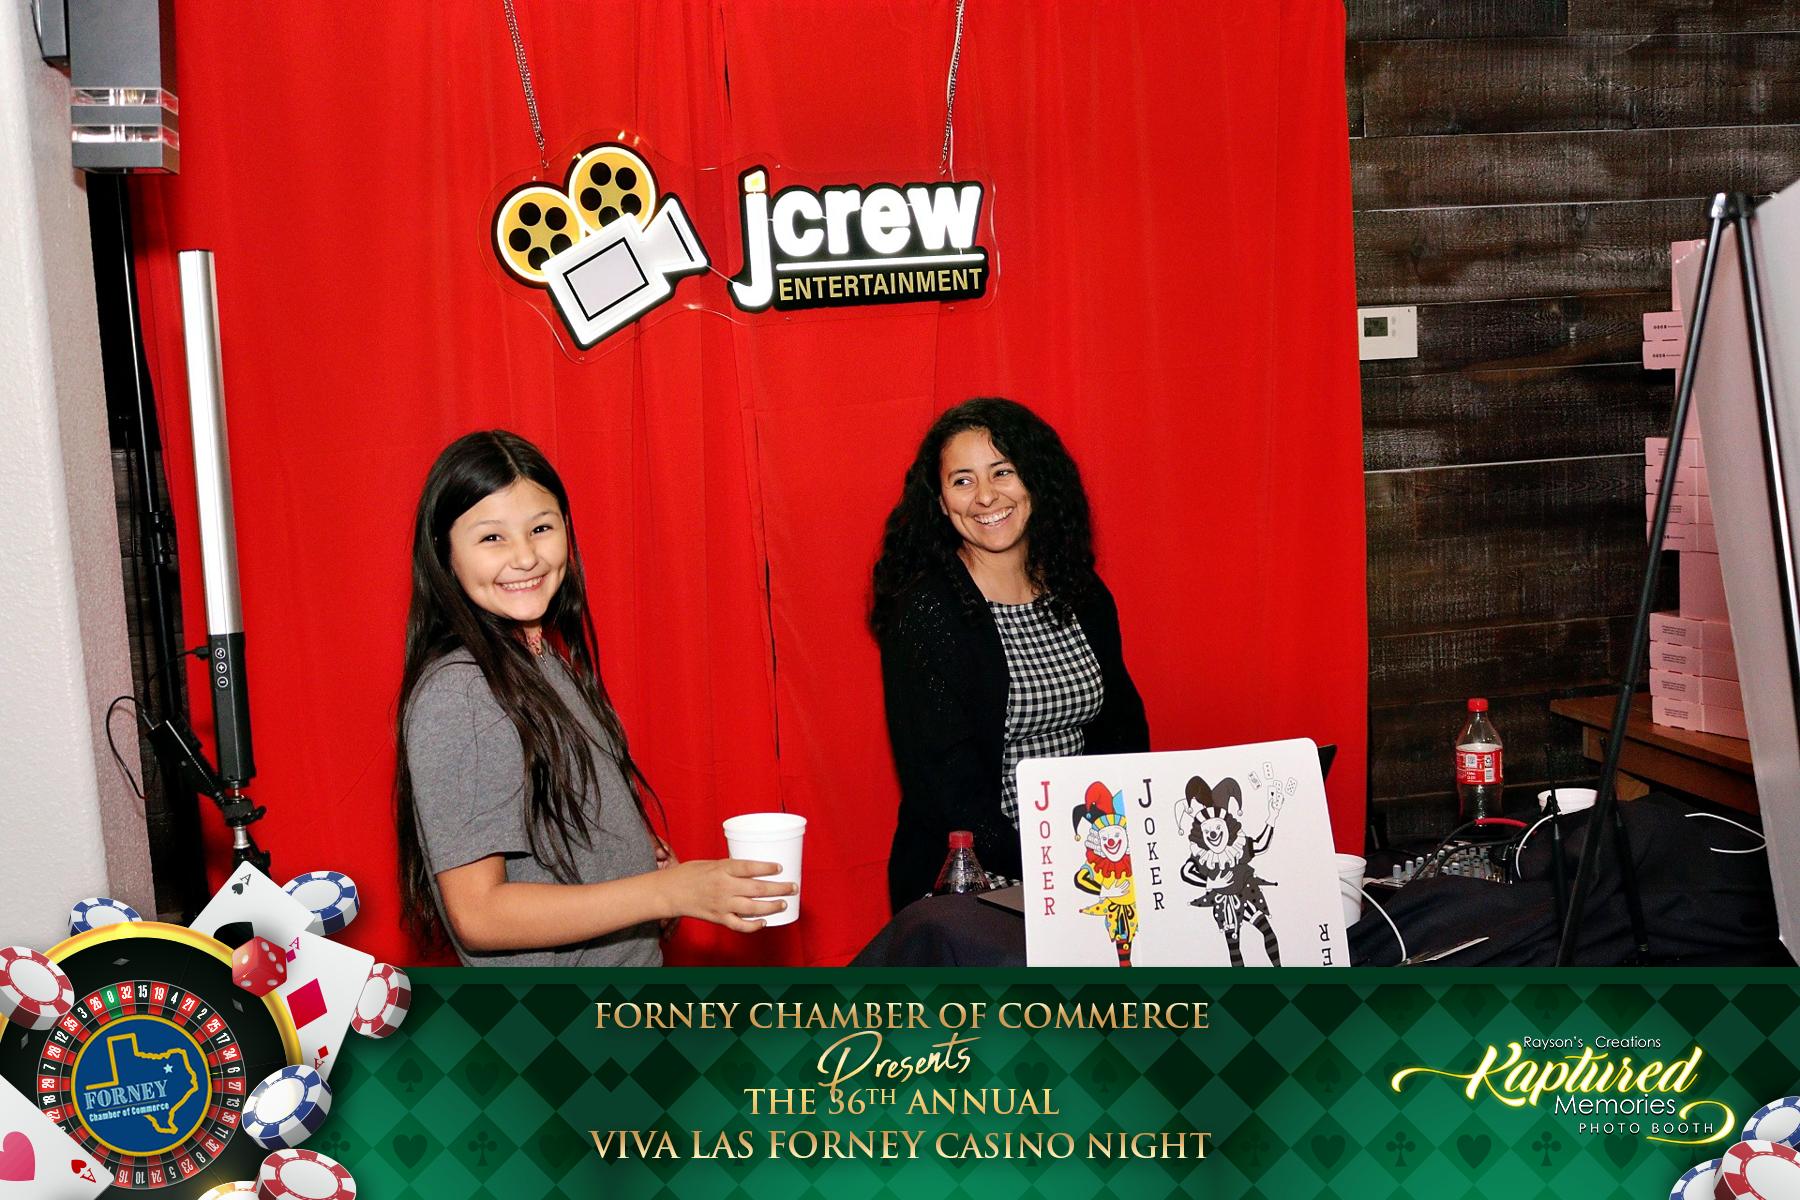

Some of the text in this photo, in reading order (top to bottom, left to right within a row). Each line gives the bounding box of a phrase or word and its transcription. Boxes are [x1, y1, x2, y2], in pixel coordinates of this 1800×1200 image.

[732, 170, 981, 307] jcrew
[778, 268, 983, 301] ENTERTAINMENT
[1035, 781, 1056, 916] JOKER
[1138, 778, 1165, 911] JOKER
